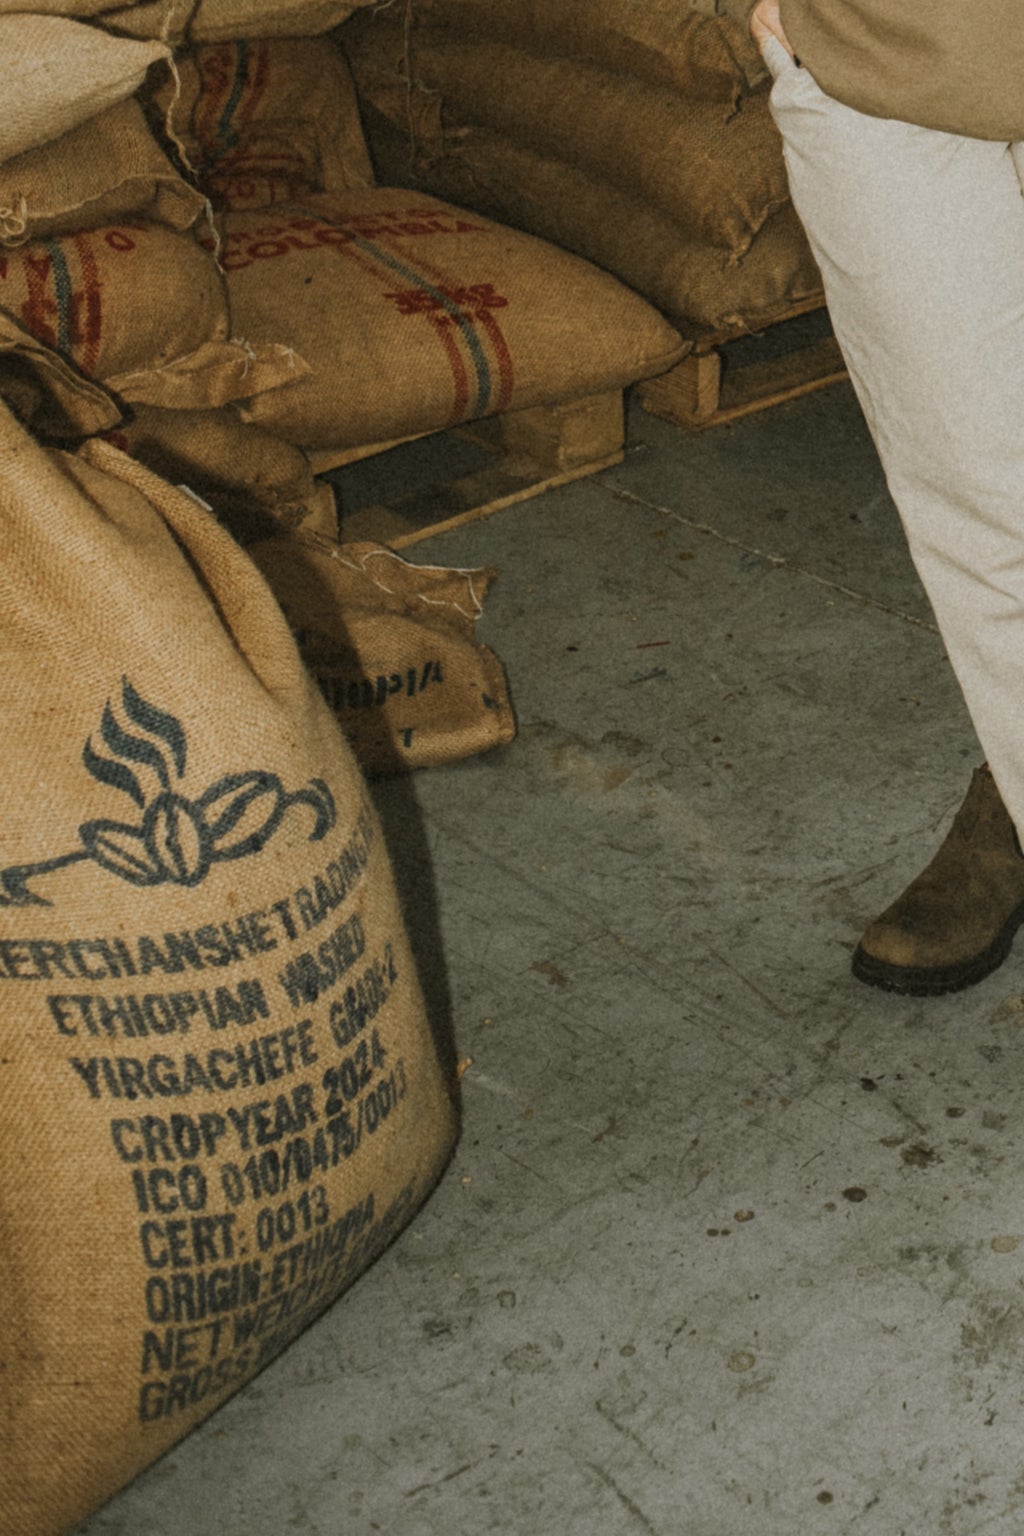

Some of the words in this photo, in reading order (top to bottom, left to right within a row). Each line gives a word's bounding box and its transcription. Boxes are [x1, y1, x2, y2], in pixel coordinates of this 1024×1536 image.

[47, 979, 271, 1038] ETHIOPIAN
[69, 1019, 319, 1102] YIRGACHEFE
[321, 1027, 388, 1117] 2024
[132, 1166, 207, 1215] ICO
[140, 1213, 247, 1271] CERT:
[256, 1184, 330, 1253] 0013
[142, 1316, 229, 1375] NET
